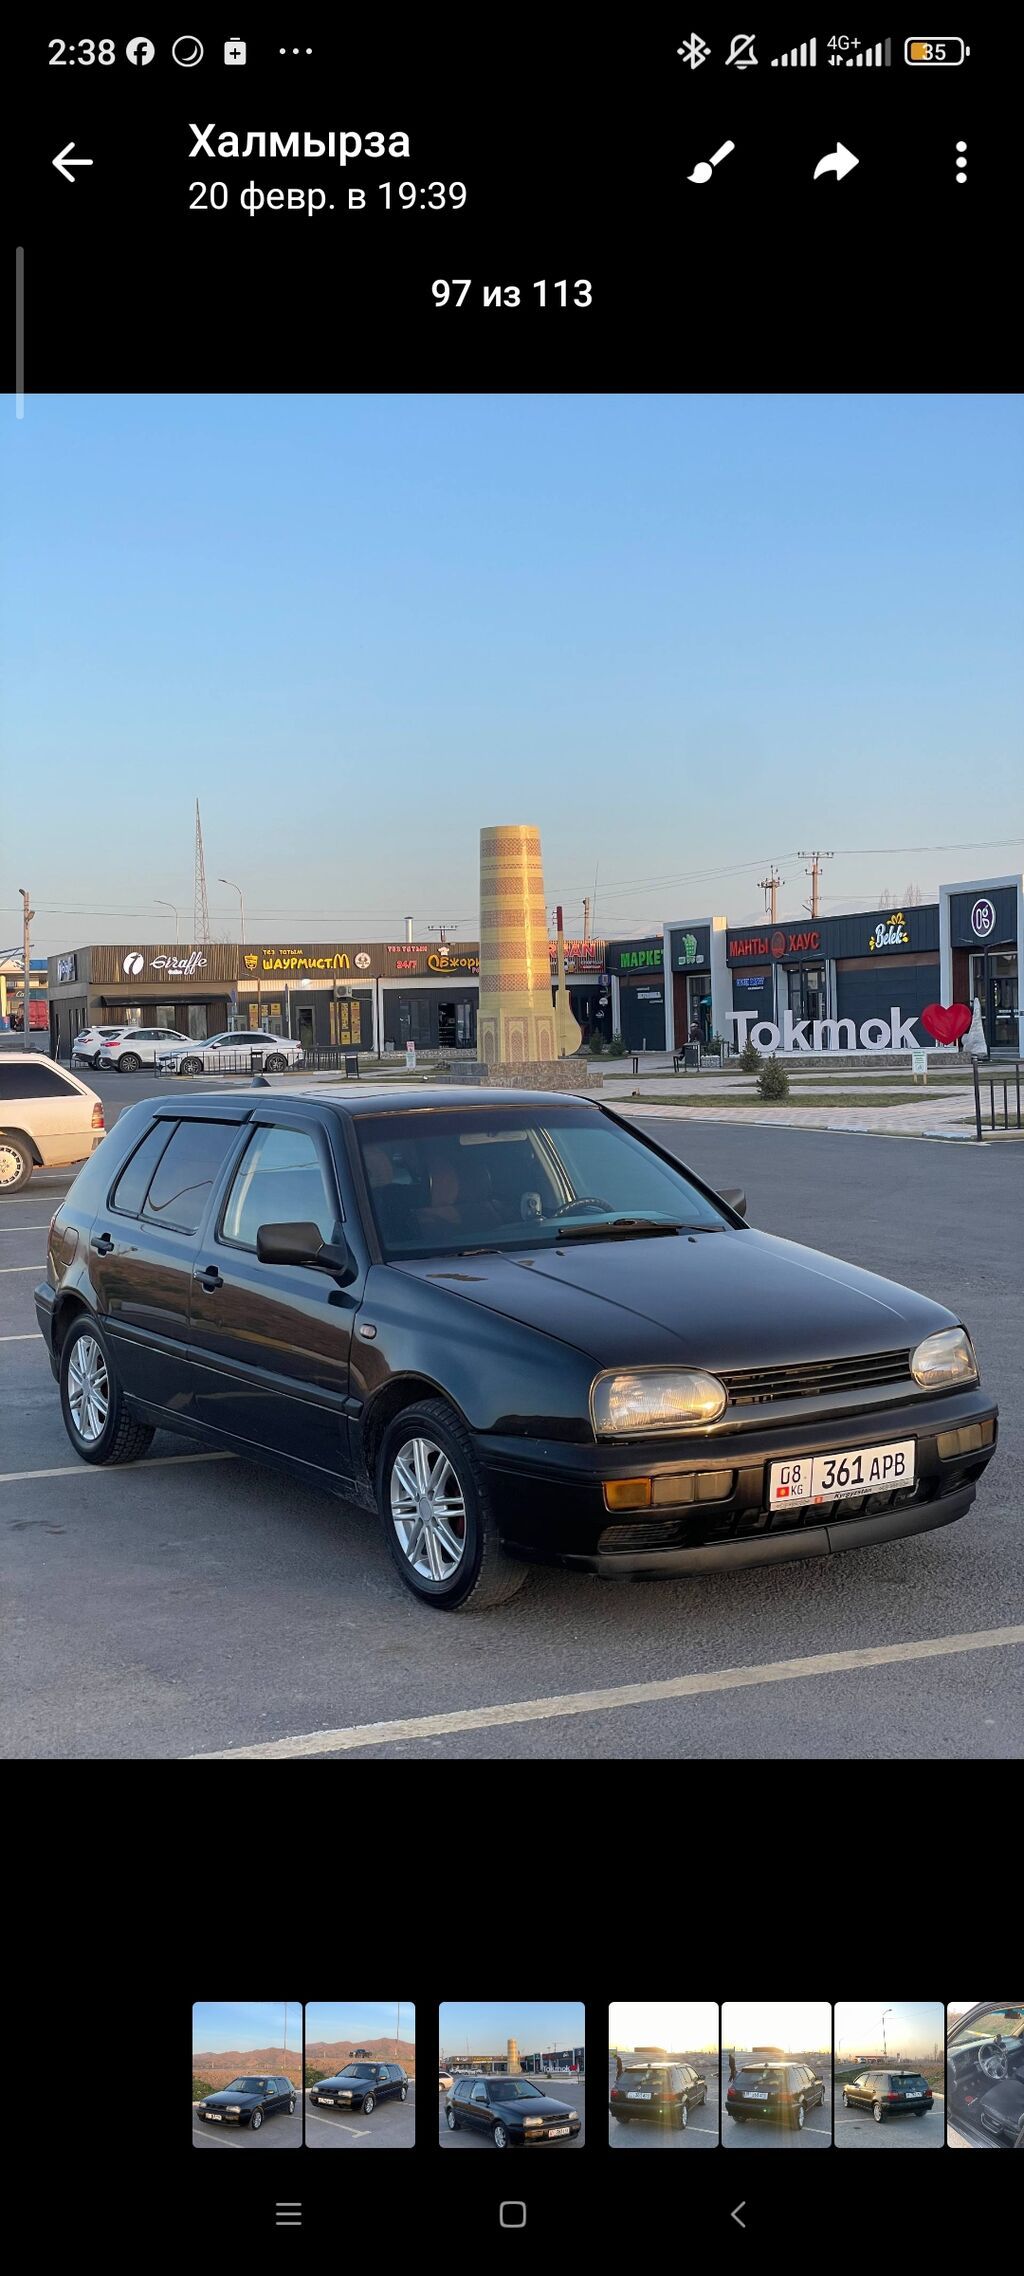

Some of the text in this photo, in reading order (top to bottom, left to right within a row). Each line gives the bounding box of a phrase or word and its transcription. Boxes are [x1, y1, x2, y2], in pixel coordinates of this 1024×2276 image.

[49, 39, 116, 66] 2:38
[827, 35, 861, 50] 4G+
[922, 43, 946, 61] 35
[188, 124, 411, 166] Халмырза
[188, 181, 467, 216] 20 февр. в 19:39
[431, 280, 593, 308] 97 из 113
[730, 931, 820, 957] МАНТЫ ХАУС
[875, 923, 903, 948] Belek
[620, 949, 665, 968] МАРКЕ
[725, 1007, 921, 1052] Tokmok
[781, 1465, 801, 1485] 08
[821, 1455, 864, 1489] 361
[869, 1453, 905, 1481] APB
[791, 1485, 803, 1496] KG
